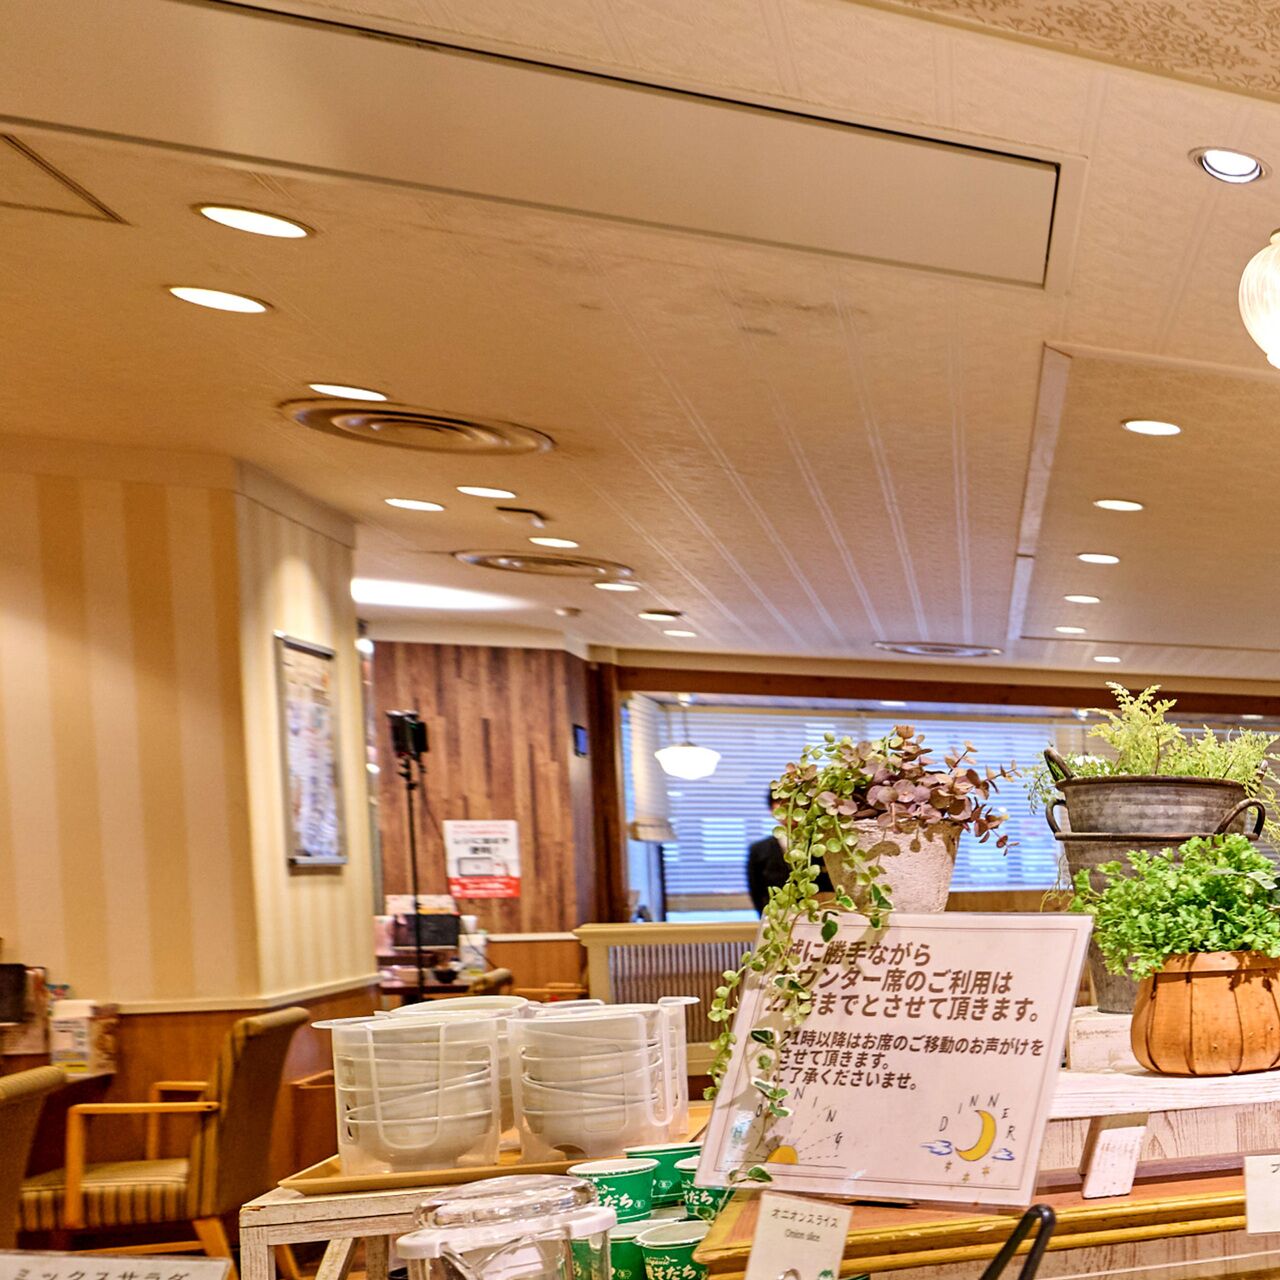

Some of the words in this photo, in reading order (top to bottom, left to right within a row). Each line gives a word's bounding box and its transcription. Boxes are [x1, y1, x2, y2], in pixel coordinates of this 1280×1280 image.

[779, 1048, 889, 1071] させて頂きます。
[772, 1066, 917, 1091] ご了承くださいませ。
[938, 1093, 1017, 1141] DINNER
[771, 1208, 838, 1229] オニオンスライス
